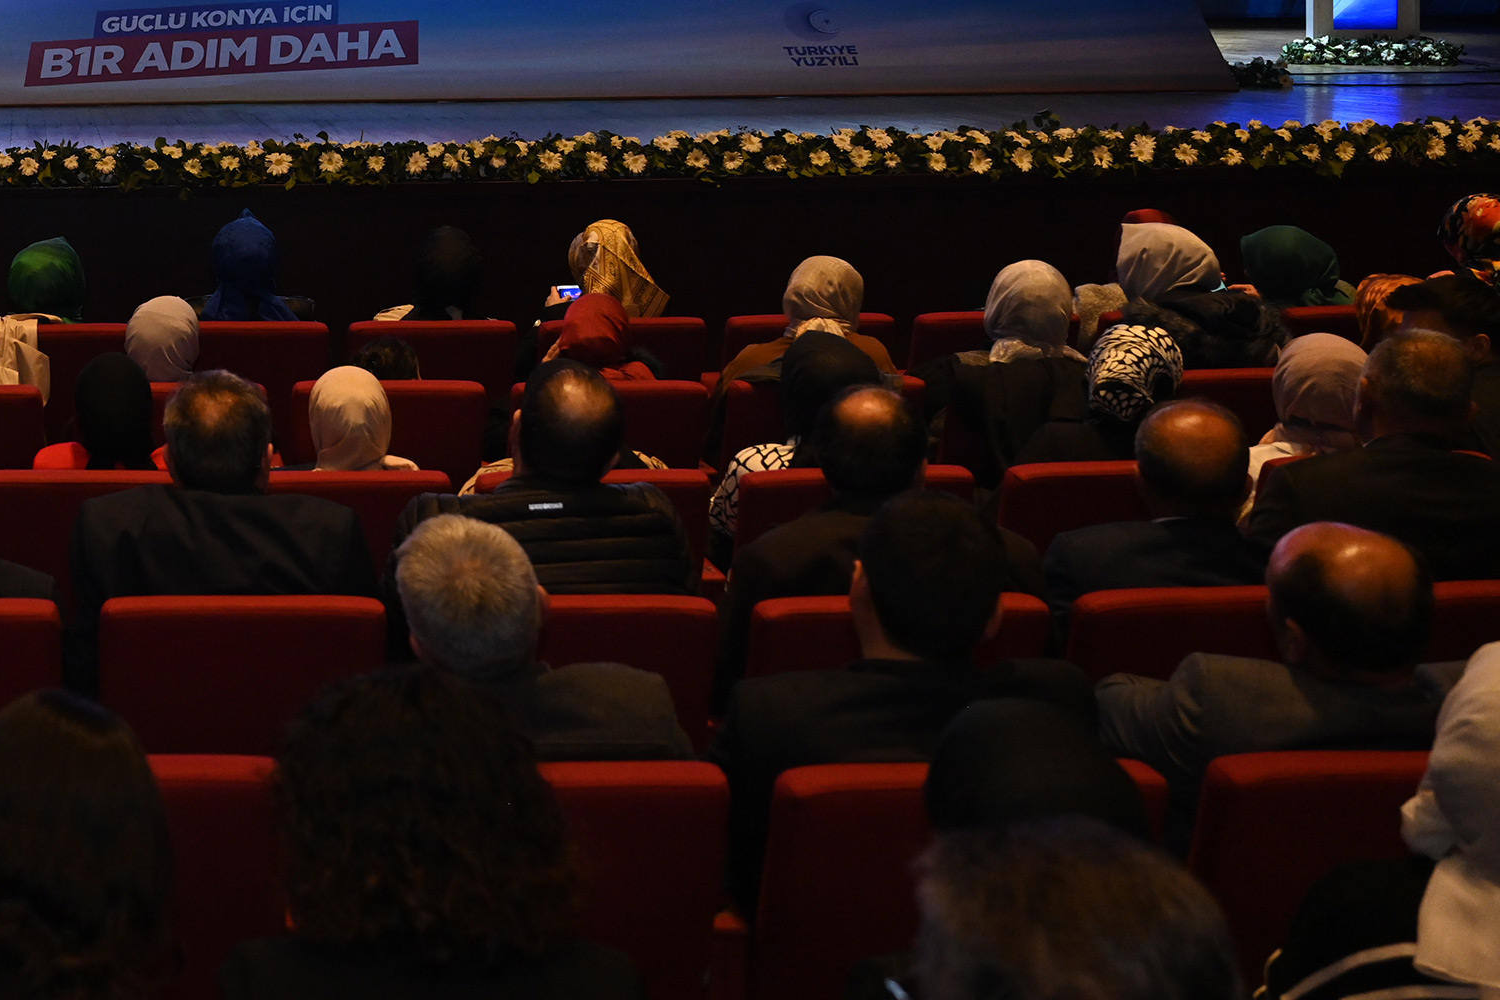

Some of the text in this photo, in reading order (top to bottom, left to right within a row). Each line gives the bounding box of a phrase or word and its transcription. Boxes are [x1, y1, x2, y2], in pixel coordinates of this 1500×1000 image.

[191, 6, 278, 29] KONYA
[39, 28, 406, 79] B1R ADIM DAHA
